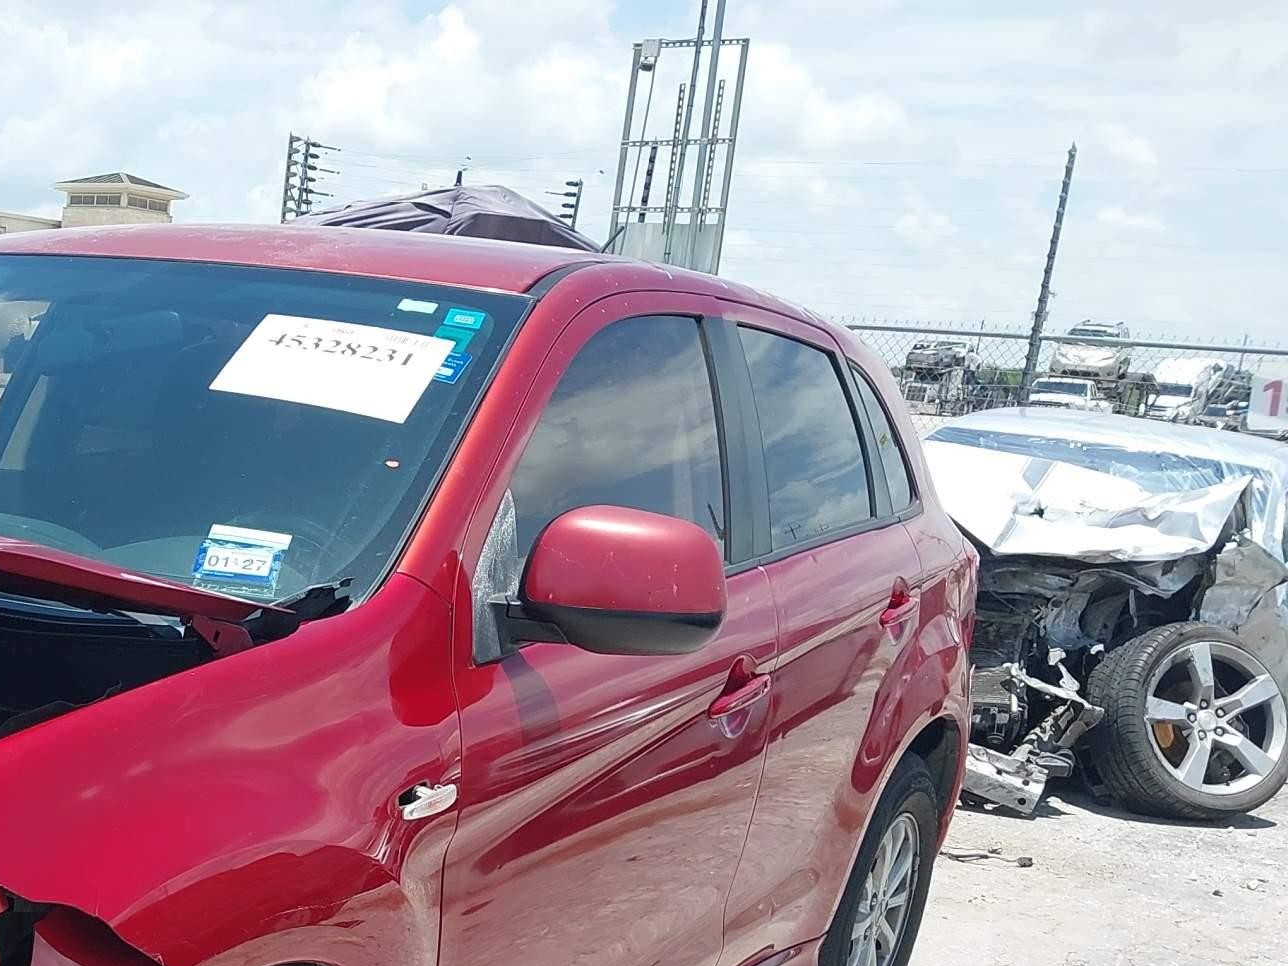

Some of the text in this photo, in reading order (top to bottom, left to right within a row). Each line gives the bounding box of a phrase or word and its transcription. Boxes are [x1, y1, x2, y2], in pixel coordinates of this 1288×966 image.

[268, 333, 413, 366] 45328231
[1263, 380, 1288, 416] 1
[208, 555, 267, 571] 01 27
